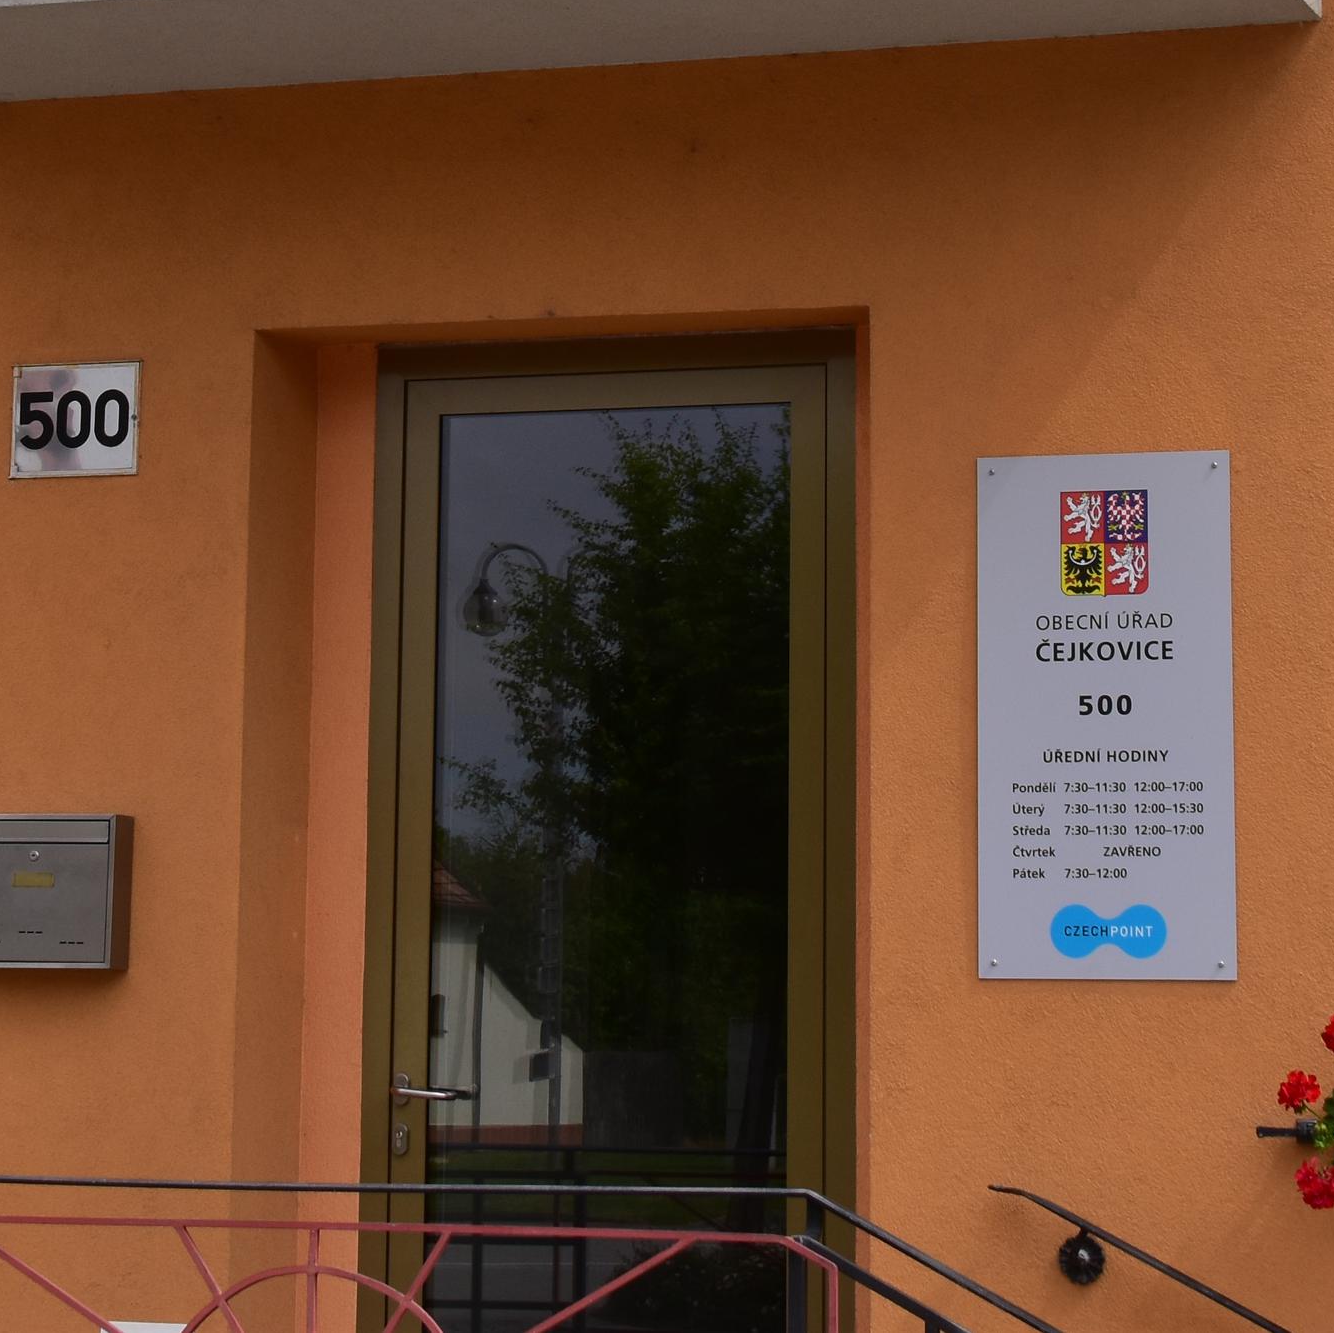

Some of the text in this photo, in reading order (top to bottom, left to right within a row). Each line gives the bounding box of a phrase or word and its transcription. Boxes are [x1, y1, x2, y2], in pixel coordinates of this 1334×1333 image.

[20, 389, 129, 450] 500
[1035, 610, 1173, 631] OBECNÍ ÚŘAD
[1035, 638, 1174, 662] ČEJKOVICE
[1078, 694, 1133, 716] 500
[1043, 748, 1169, 763] ÚŘEDNÍ HODINY
[1012, 782, 1056, 793] Pondělí
[1012, 802, 1045, 817] Úterý
[1012, 825, 1051, 836] Středa
[1012, 845, 1162, 858] Čtvrtek ZAVŘENO
[1012, 868, 1046, 879] Pátek
